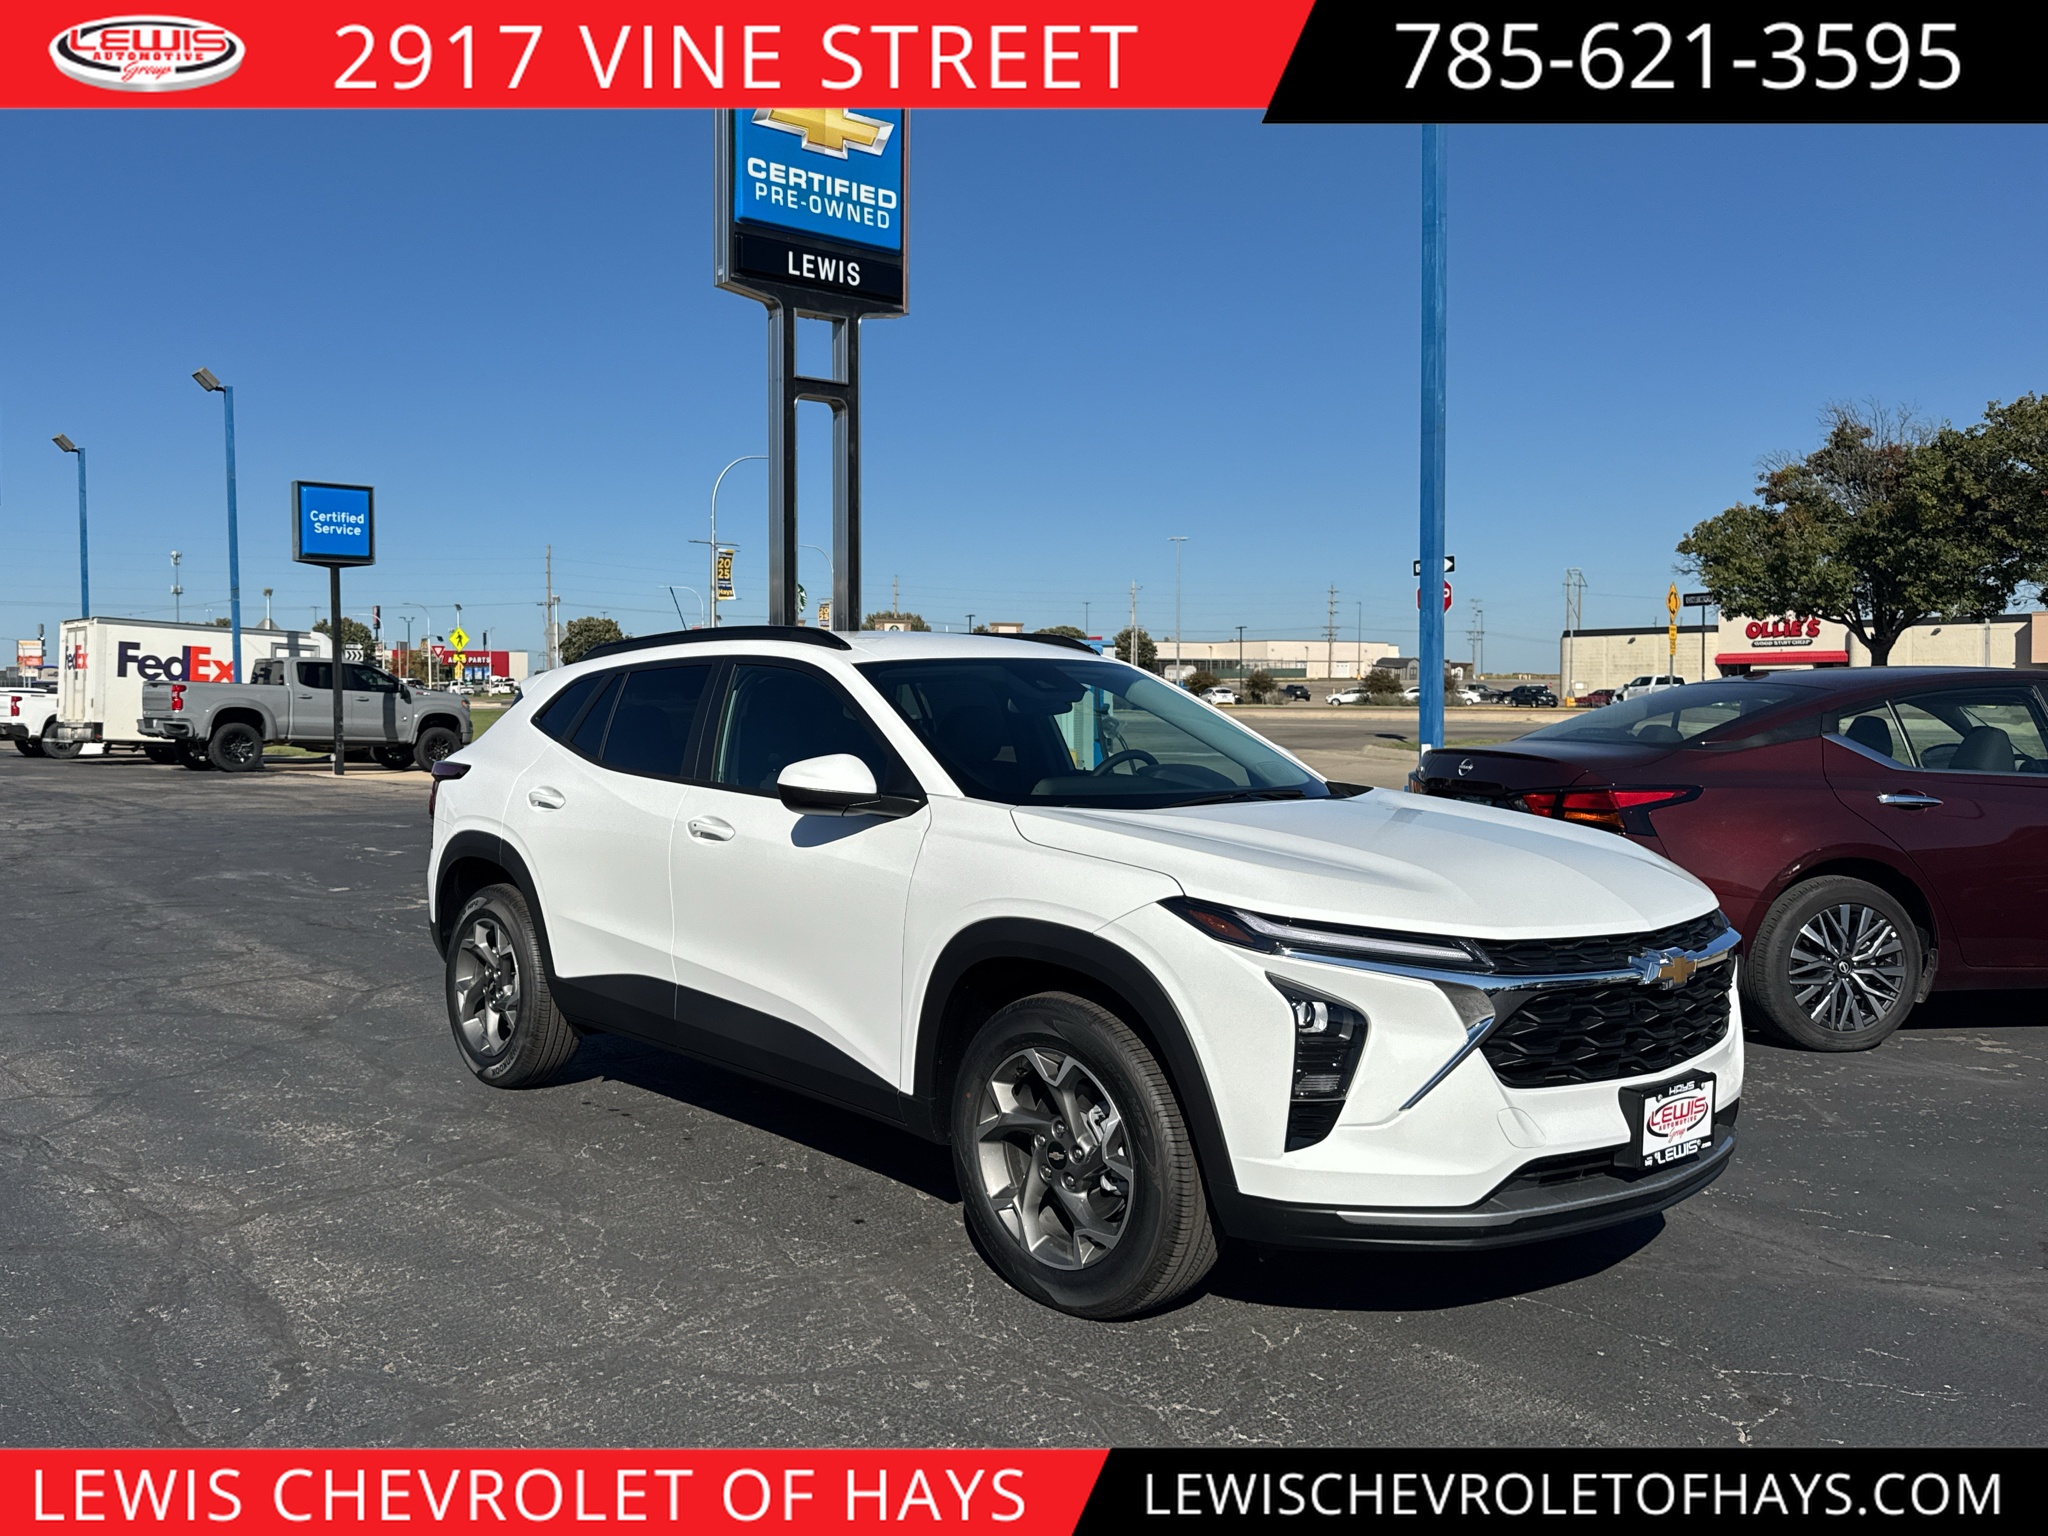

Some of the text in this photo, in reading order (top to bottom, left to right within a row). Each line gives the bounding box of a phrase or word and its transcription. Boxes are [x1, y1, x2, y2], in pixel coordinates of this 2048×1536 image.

[747, 157, 896, 209] CERTIFIED
[755, 182, 889, 229] PRE-OWNED
[788, 251, 860, 286] LEWIS
[310, 510, 364, 524] Certified
[314, 522, 361, 535] Service
[719, 558, 731, 568] 20
[718, 569, 730, 579] 25
[117, 641, 233, 682] FedEx
[1669, 1081, 1695, 1095] HAYS
[1651, 1097, 1706, 1127] LEWIS
[1659, 1115, 1697, 1131] AUTOMOTIVE
[1657, 1141, 1698, 1164] LEWIS
